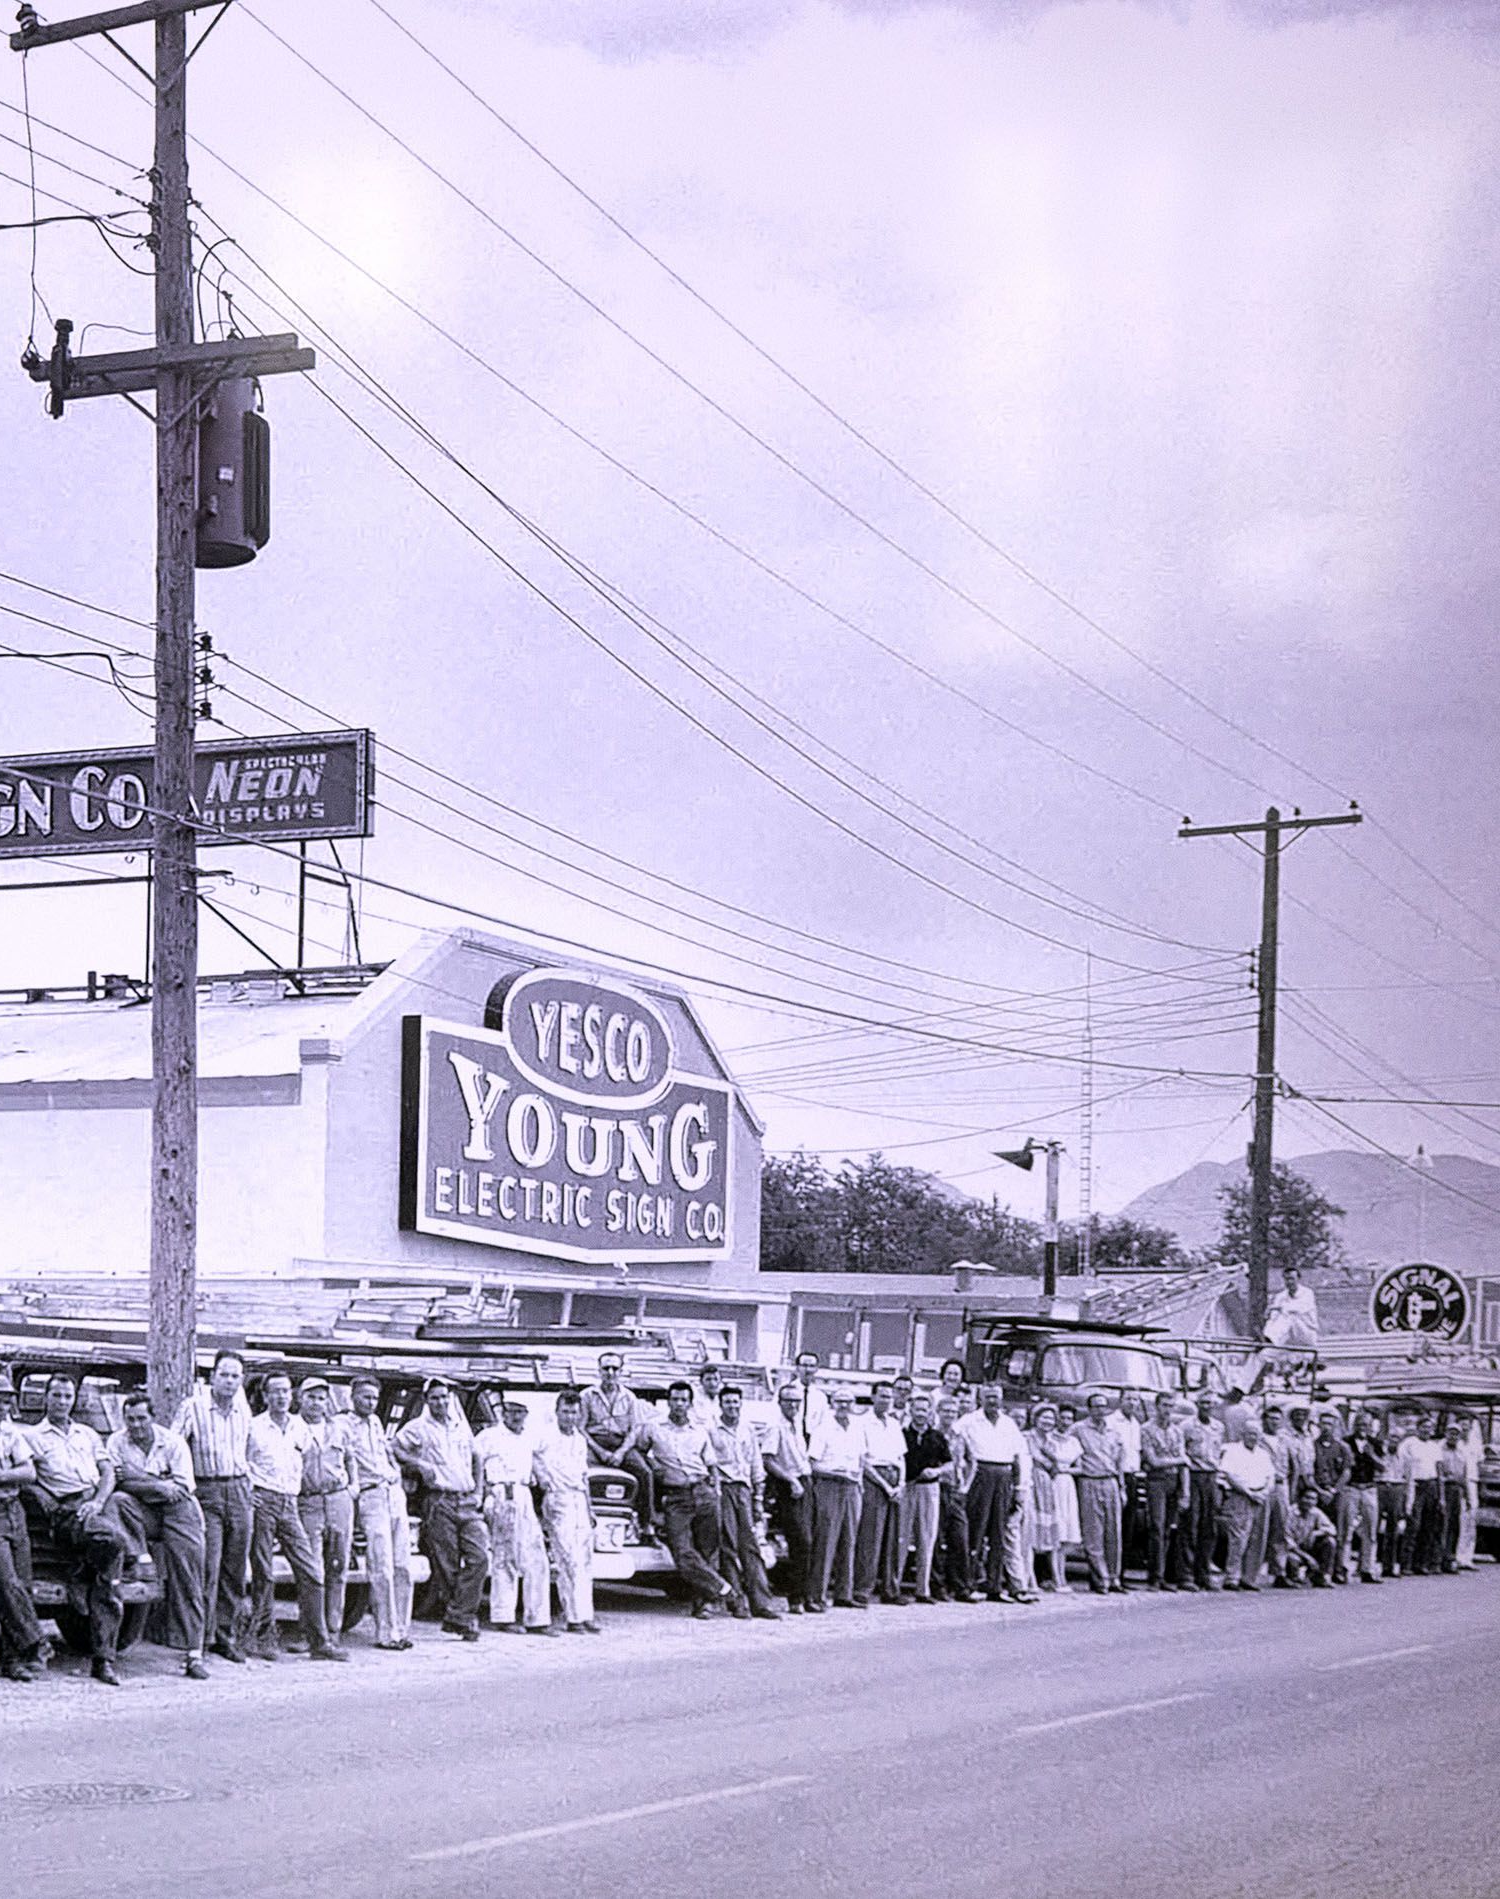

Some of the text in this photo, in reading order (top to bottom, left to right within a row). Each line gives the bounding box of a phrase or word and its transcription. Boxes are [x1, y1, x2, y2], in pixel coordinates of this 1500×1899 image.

[203, 759, 323, 804] NEON
[202, 802, 326, 825] DISPLAYS
[529, 1000, 651, 1083] YESCO
[446, 1050, 717, 1191] YOUNG
[434, 1166, 593, 1228] ELECTRIC
[605, 1189, 676, 1238] SIGN
[1379, 1268, 1461, 1310] SIGNAL
